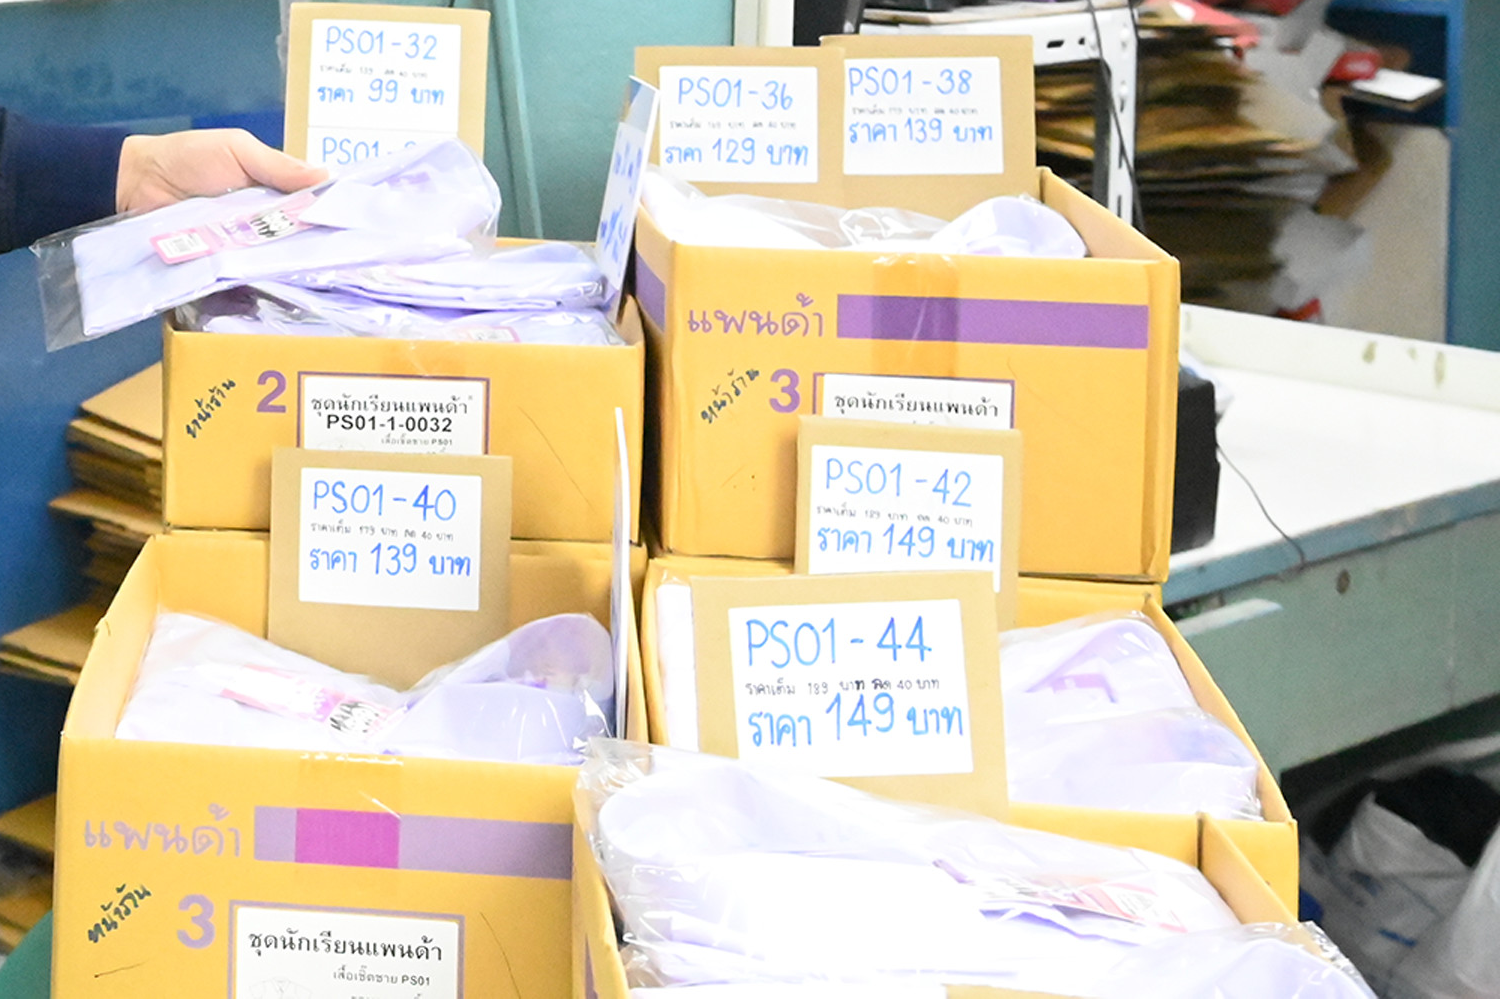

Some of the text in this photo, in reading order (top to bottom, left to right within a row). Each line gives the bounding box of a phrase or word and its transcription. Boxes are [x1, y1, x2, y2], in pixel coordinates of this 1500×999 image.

[325, 25, 438, 60] PS01-32
[317, 78, 445, 105] ราคา 99 บาท
[677, 76, 794, 110] PS01-36
[848, 65, 973, 97] PS01-38
[848, 117, 993, 144] ราคา 139 บาท
[664, 137, 808, 166] ราคา 129 บาท
[687, 292, 825, 337] แพนด้า
[256, 370, 287, 413] 2
[769, 369, 801, 413] 3
[834, 390, 999, 418] ชุดนักเรียนแพนด้า
[326, 414, 453, 433] PS01-1-0032
[826, 458, 972, 507] PS01-42
[313, 480, 456, 521] PS01-40
[310, 542, 471, 576] ราคา 139 บาท
[817, 523, 994, 562] ราคา 149 บาท
[746, 616, 932, 669] PS01-44
[748, 692, 963, 747] ราคา 149 บาท
[83, 803, 240, 857] แพนด้า
[176, 893, 216, 949] 3
[248, 928, 443, 962] ชุดนักเรียนแพนด้า
[401, 974, 430, 986] PS01
